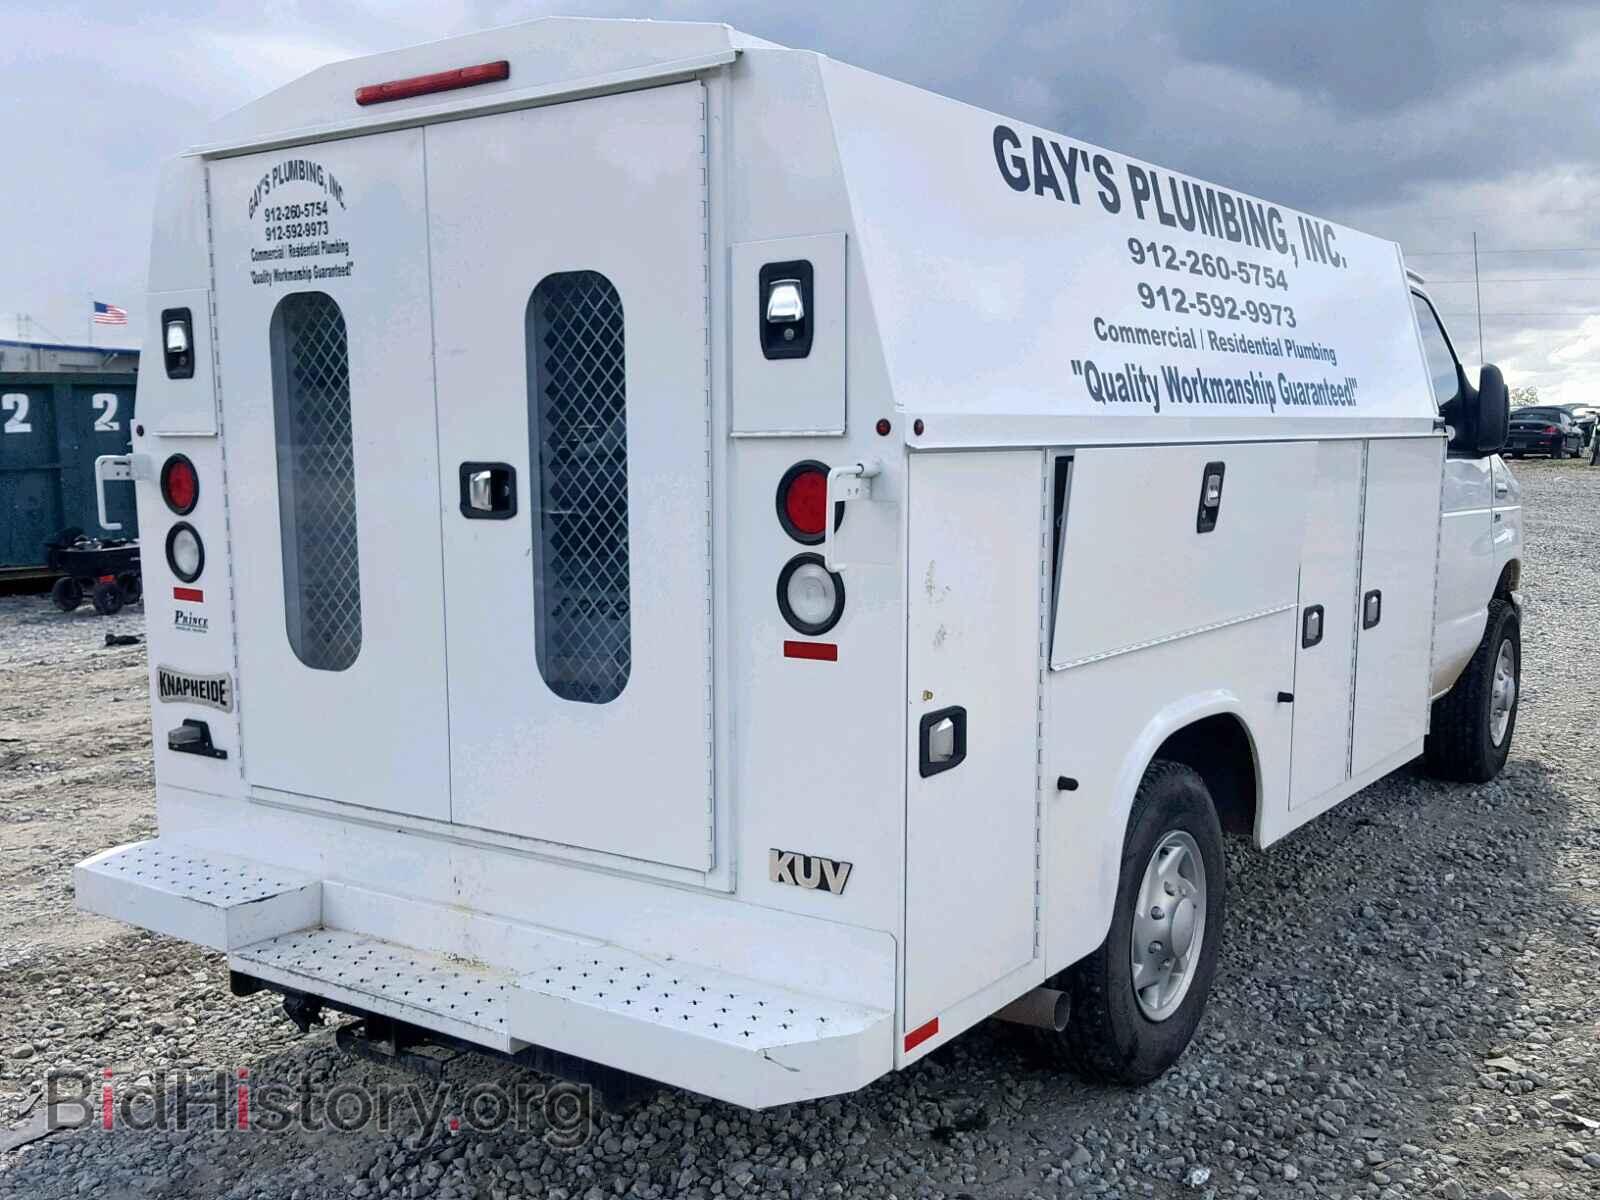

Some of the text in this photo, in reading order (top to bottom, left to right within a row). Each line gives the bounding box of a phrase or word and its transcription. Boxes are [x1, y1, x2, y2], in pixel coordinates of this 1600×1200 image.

[264, 201, 328, 222] 912-260-5754
[992, 124, 1348, 269] GAY'S PLUMBING, INC.
[265, 220, 329, 241] 912-592-9973
[1127, 237, 1289, 292] 912-260-5754
[1137, 282, 1297, 329] 912-592-9973
[1093, 316, 1197, 351] Commercial
[1208, 329, 1283, 358] Residential
[1284, 340, 1337, 367] Plumbing
[1070, 359, 1359, 414] "Quality Workmanship Guaranteed!"
[1, 393, 32, 433] 2
[92, 393, 120, 432] 2
[158, 670, 227, 707] KNAPHEIDE
[768, 848, 853, 896] KUV
